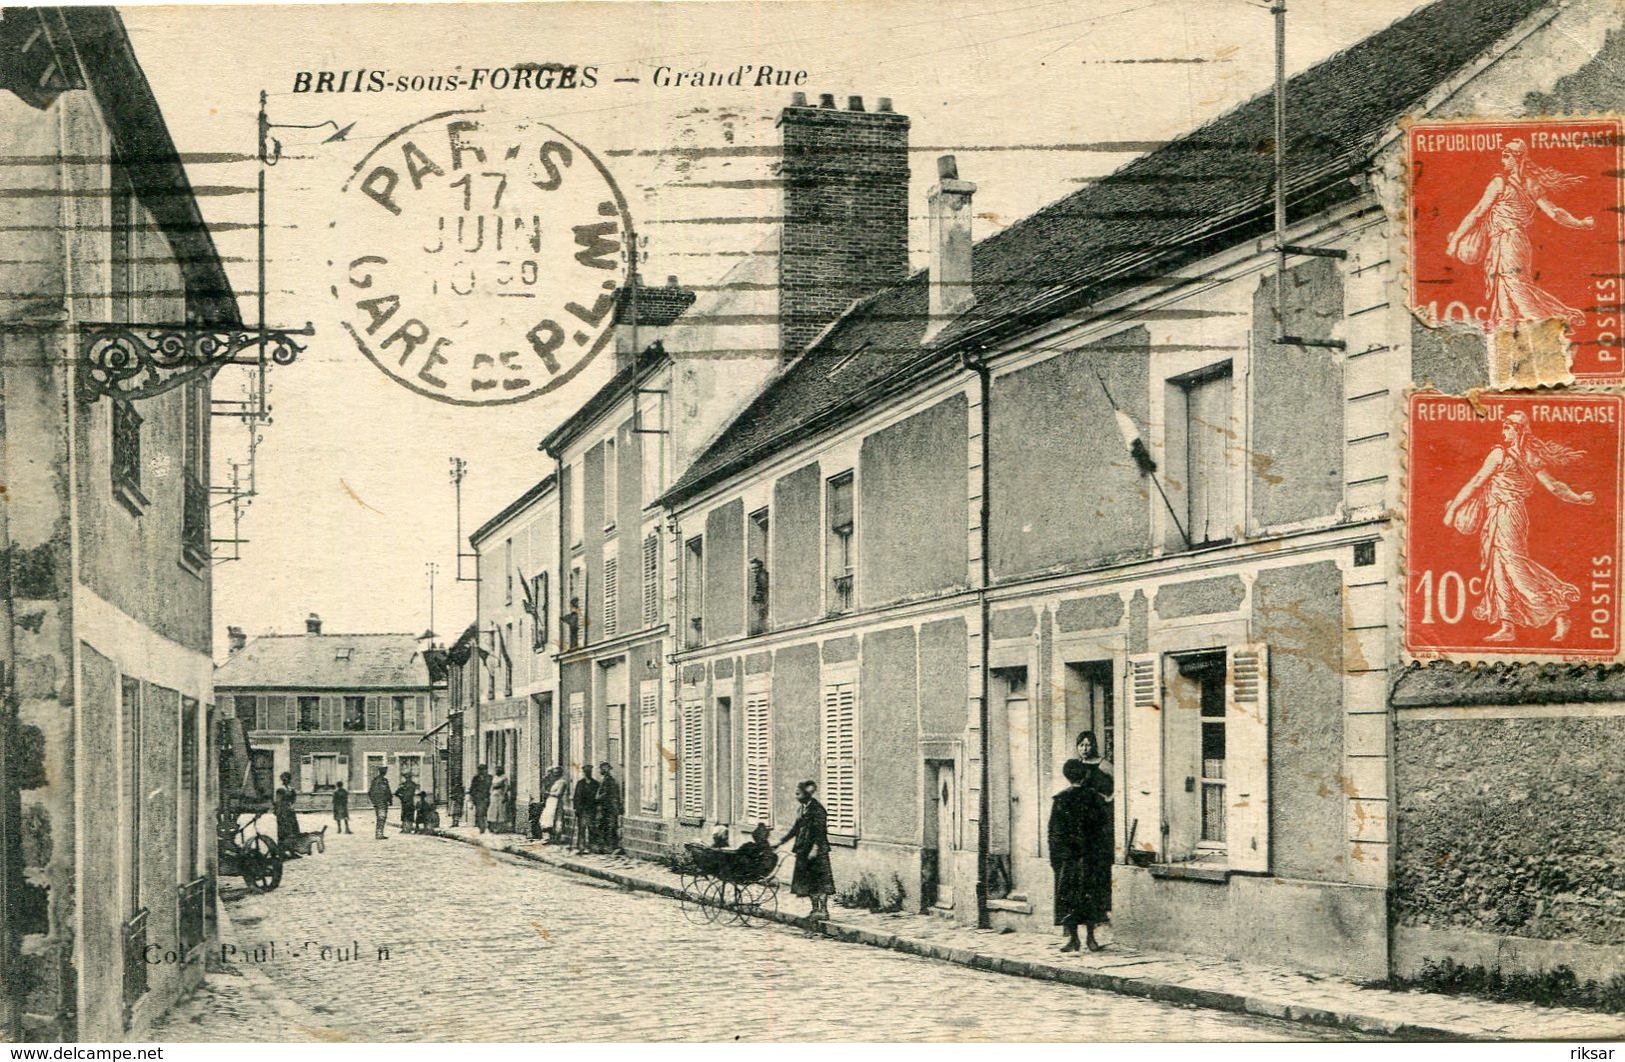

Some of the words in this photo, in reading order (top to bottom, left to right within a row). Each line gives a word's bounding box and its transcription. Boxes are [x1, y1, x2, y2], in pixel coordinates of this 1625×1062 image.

[1417, 133, 1504, 152] REPUBLIQUE
[449, 172, 508, 211] 17
[349, 255, 452, 390] GARE
[1596, 278, 1617, 362] POSTES
[1532, 405, 1615, 424] FRANÇAISE
[1590, 554, 1612, 639] POSTES
